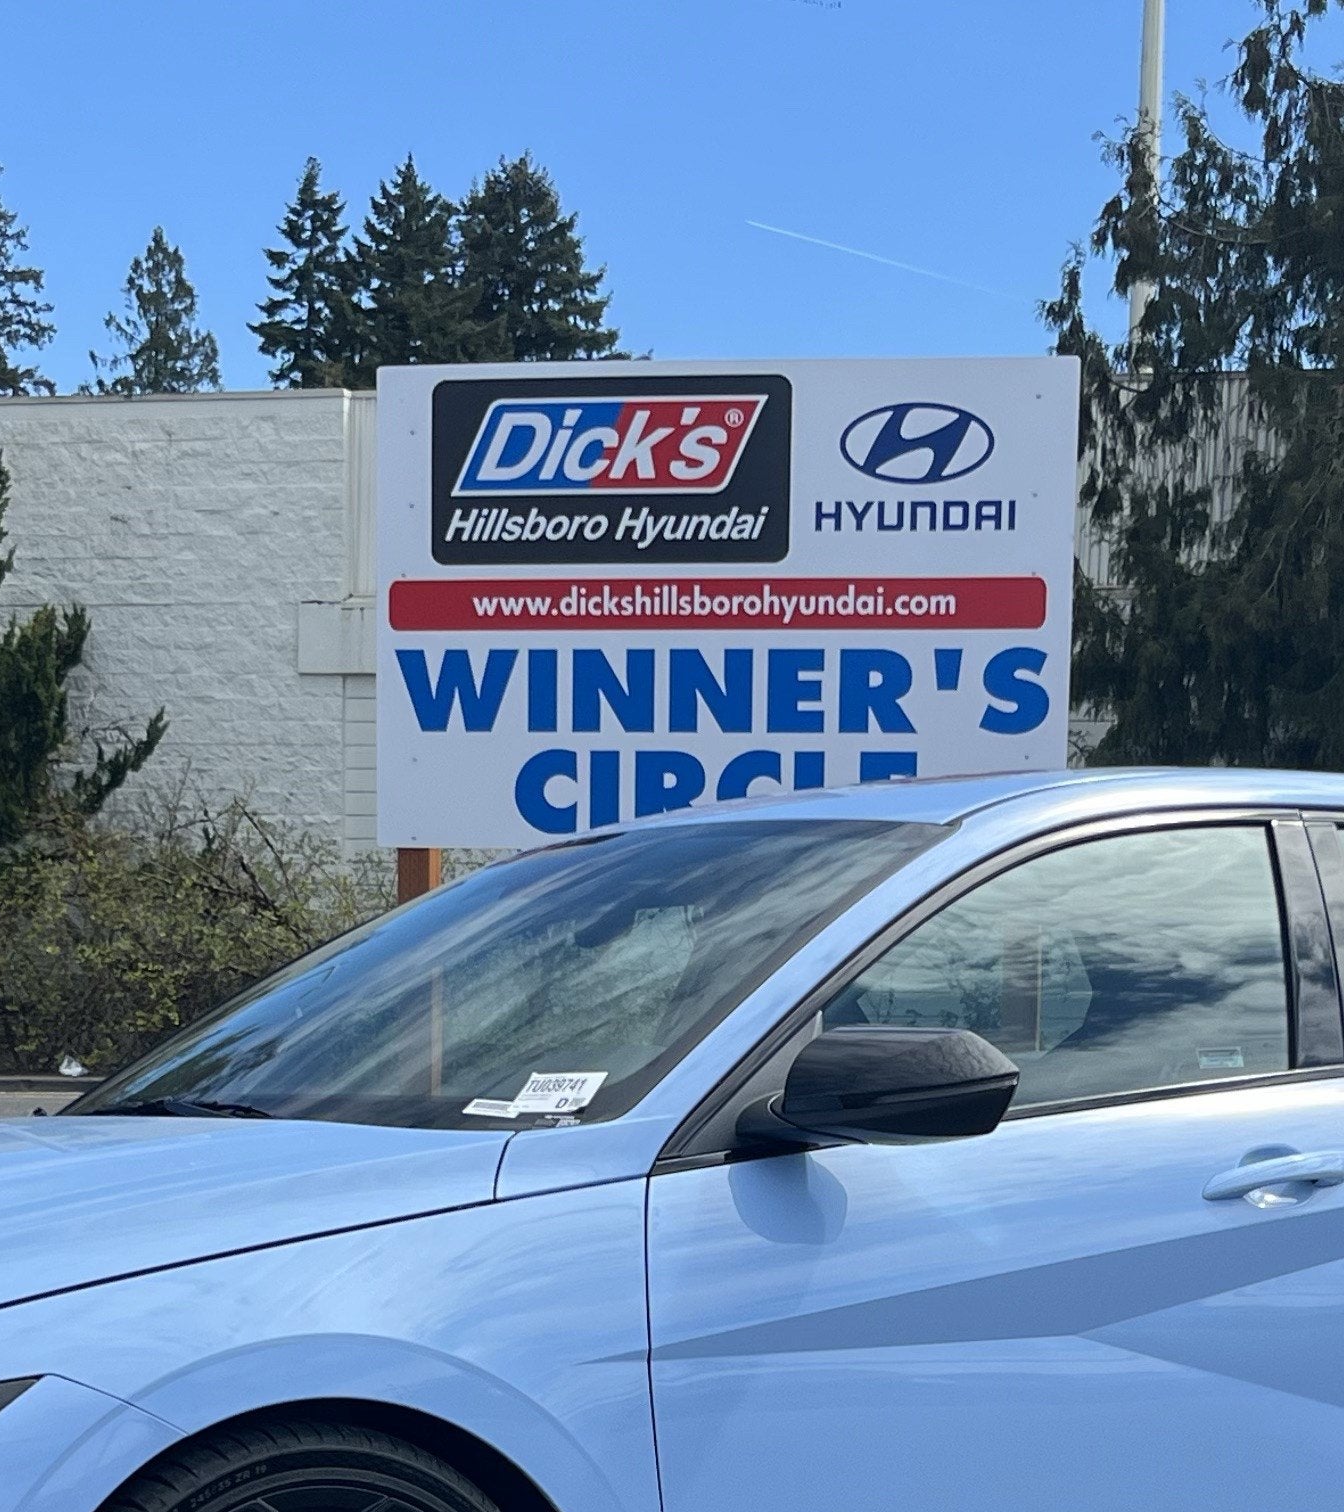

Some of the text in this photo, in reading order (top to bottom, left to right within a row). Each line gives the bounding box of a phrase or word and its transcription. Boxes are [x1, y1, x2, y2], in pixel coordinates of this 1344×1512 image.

[477, 405, 727, 483] Dick's
[445, 506, 769, 549] Hillsboro Hyundai
[814, 500, 1017, 533] HYUNDAI
[472, 584, 957, 625] www.dickshillsborohyundai.com
[396, 646, 1050, 735] WINNER'S
